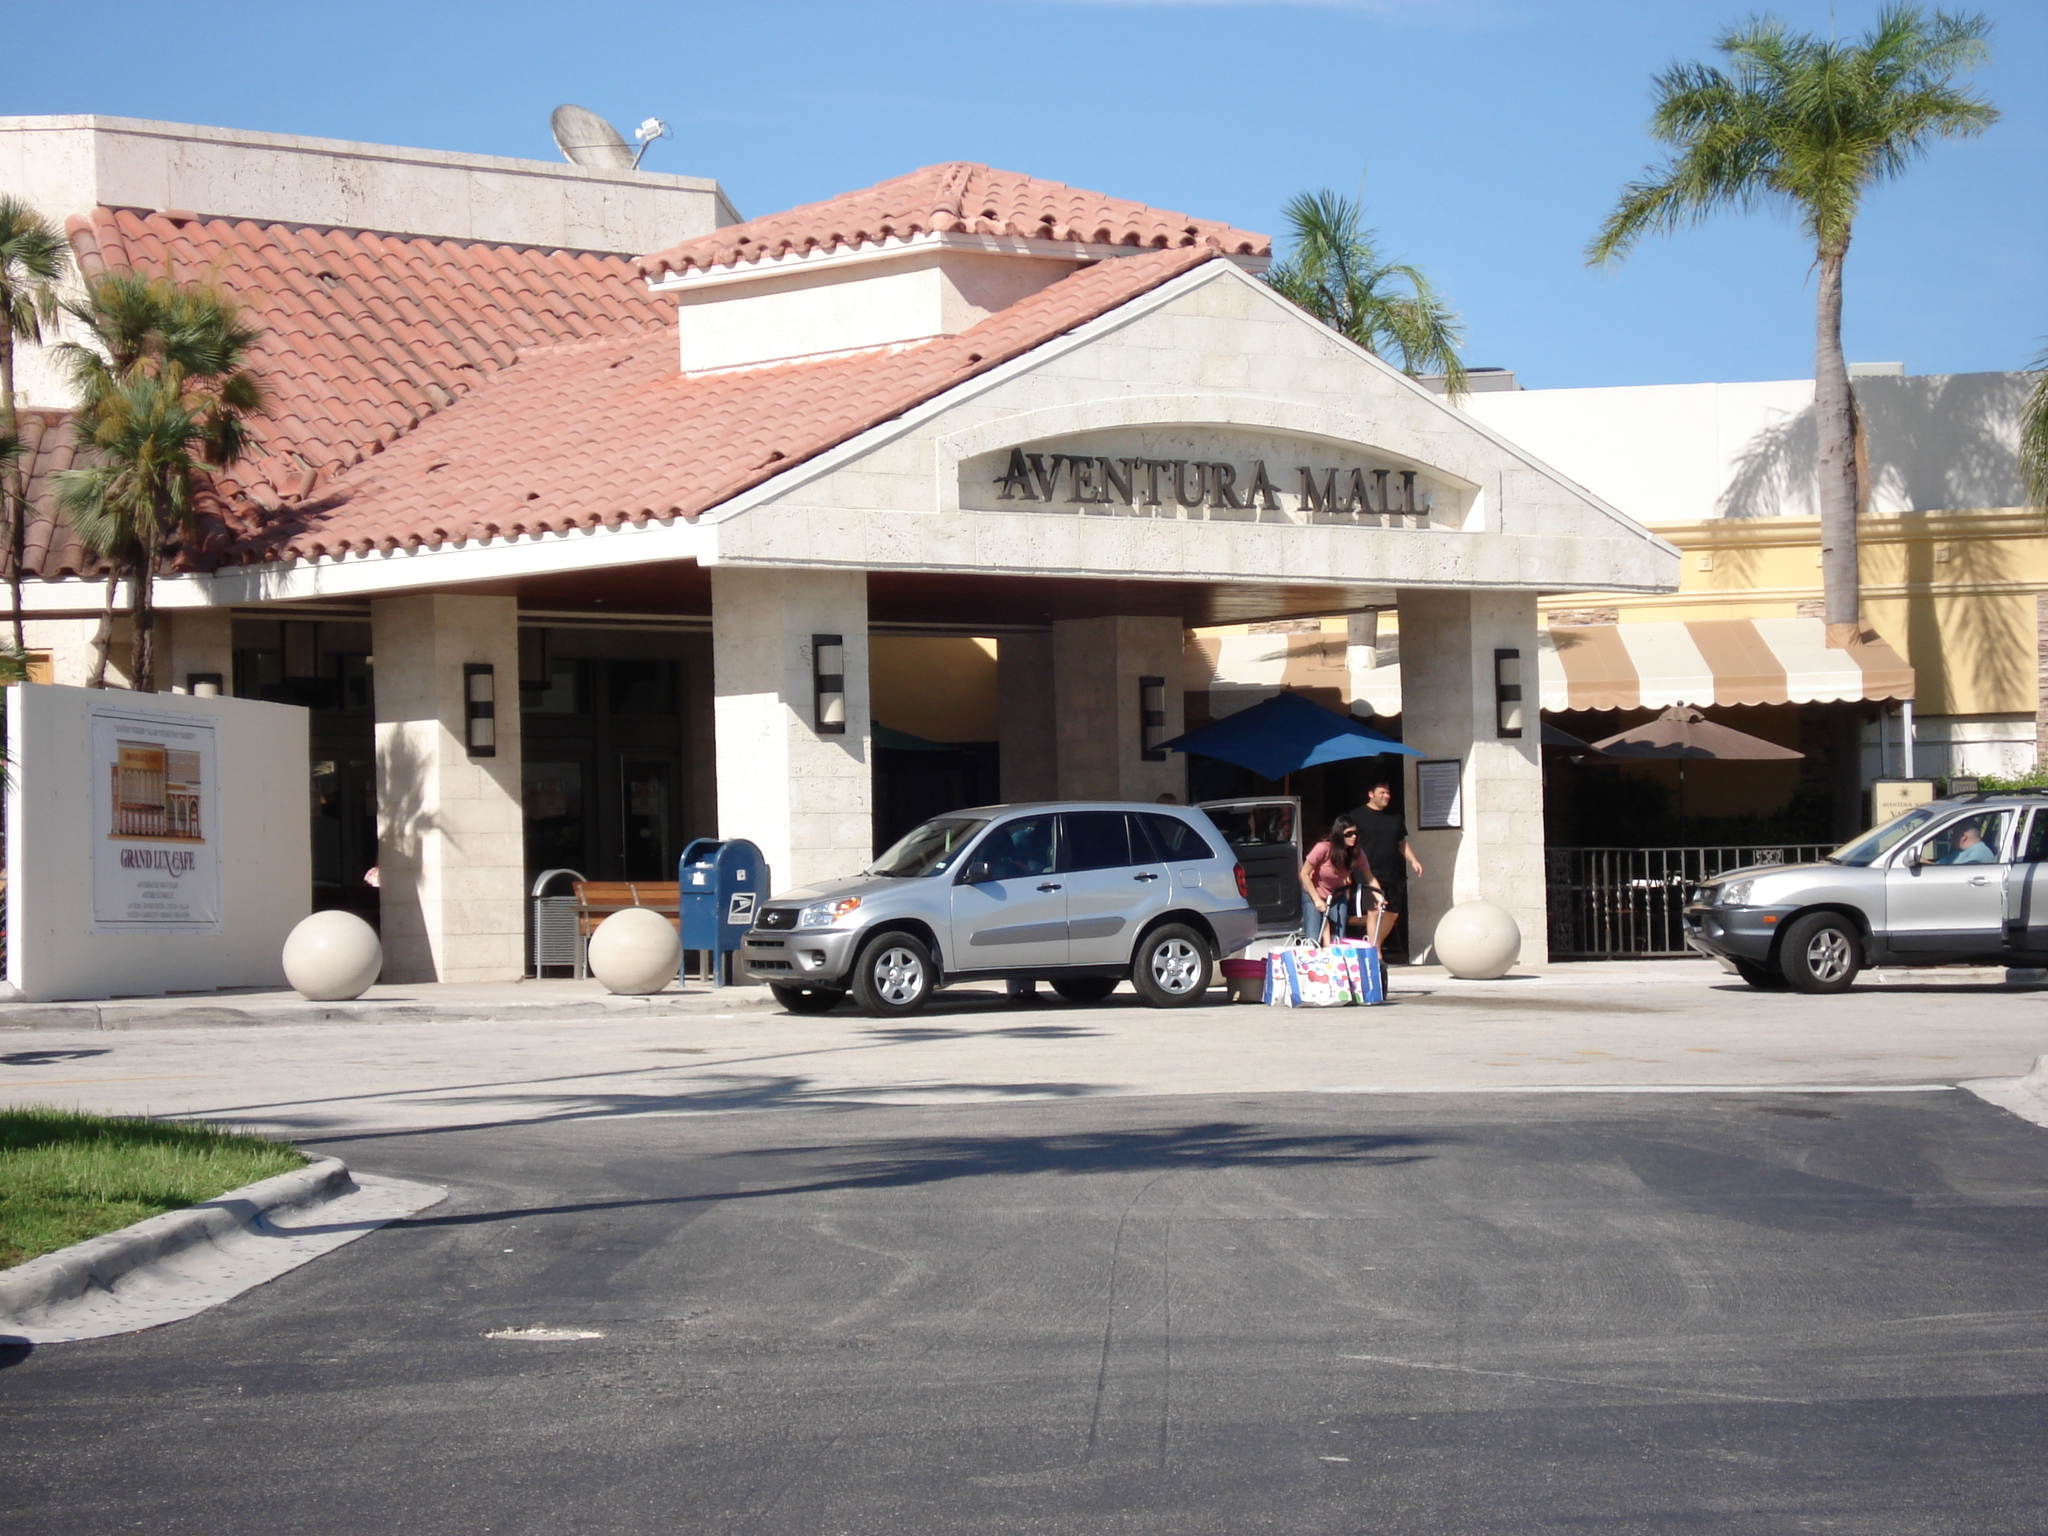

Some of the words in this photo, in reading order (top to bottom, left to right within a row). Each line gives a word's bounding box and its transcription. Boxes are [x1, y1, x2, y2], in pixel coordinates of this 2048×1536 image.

[992, 446, 1281, 511] AVENTURA
[1296, 465, 1430, 516] MALL
[120, 848, 152, 869] GRAND
[172, 851, 196, 871] CAFE
[1298, 956, 1330, 965] Sanrio
